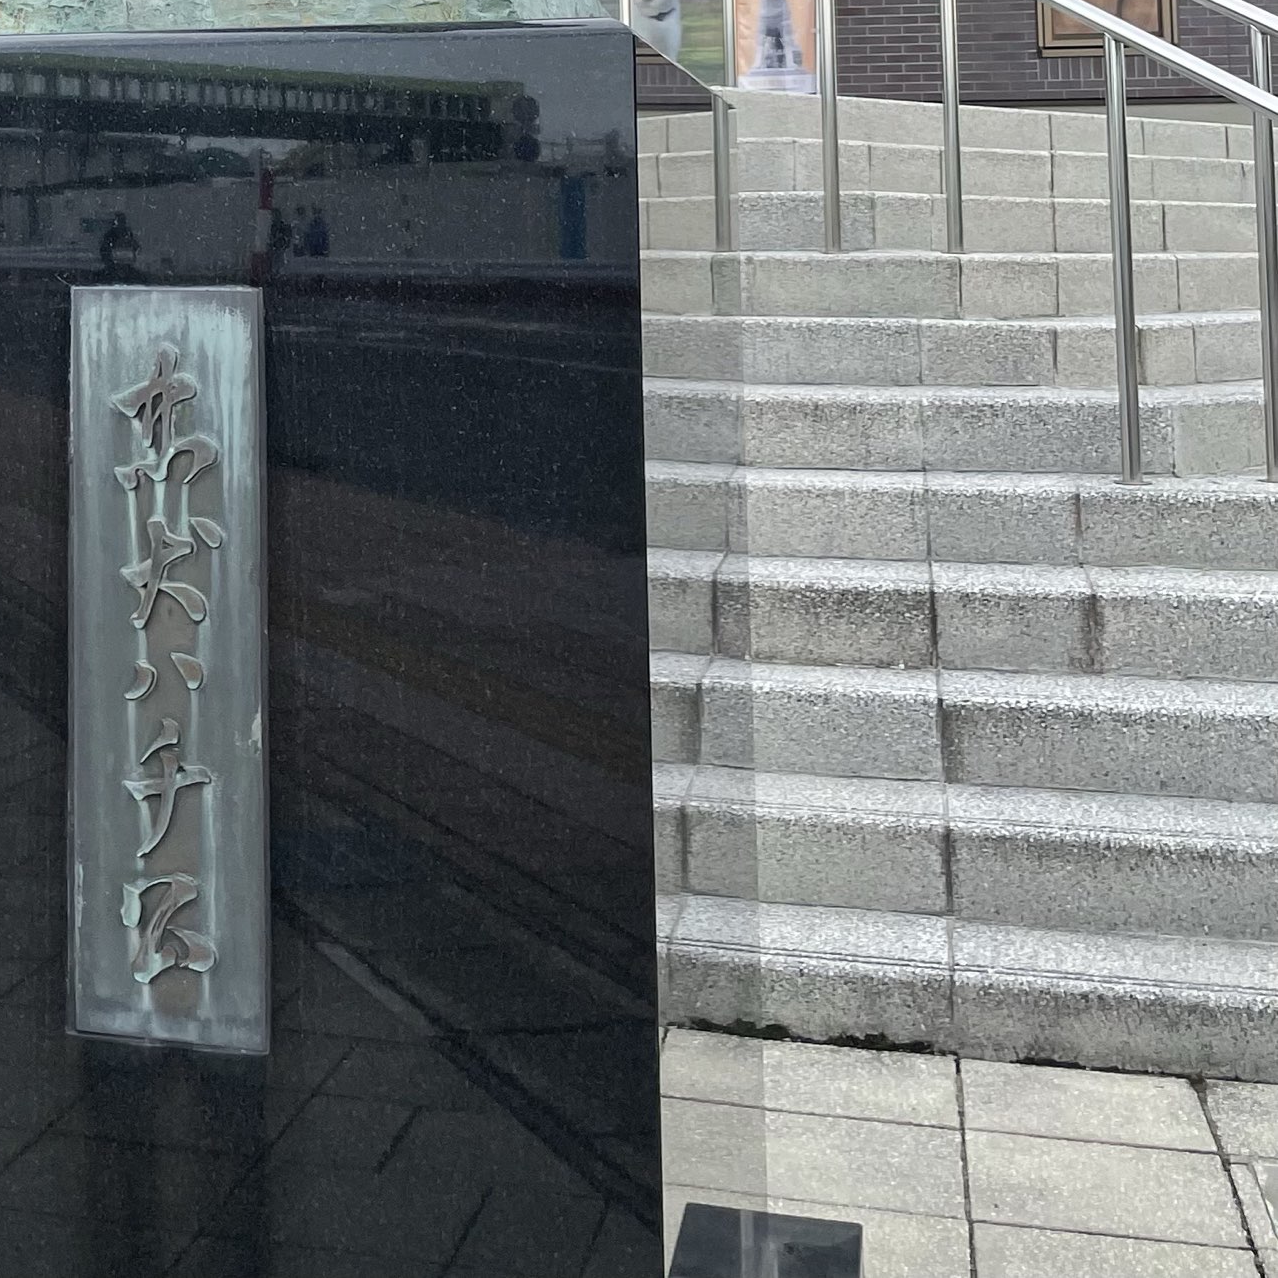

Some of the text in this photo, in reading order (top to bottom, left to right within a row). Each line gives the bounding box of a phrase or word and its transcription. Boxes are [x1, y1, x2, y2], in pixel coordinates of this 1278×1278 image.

[111, 341, 223, 985] 忠犬ハチ公
